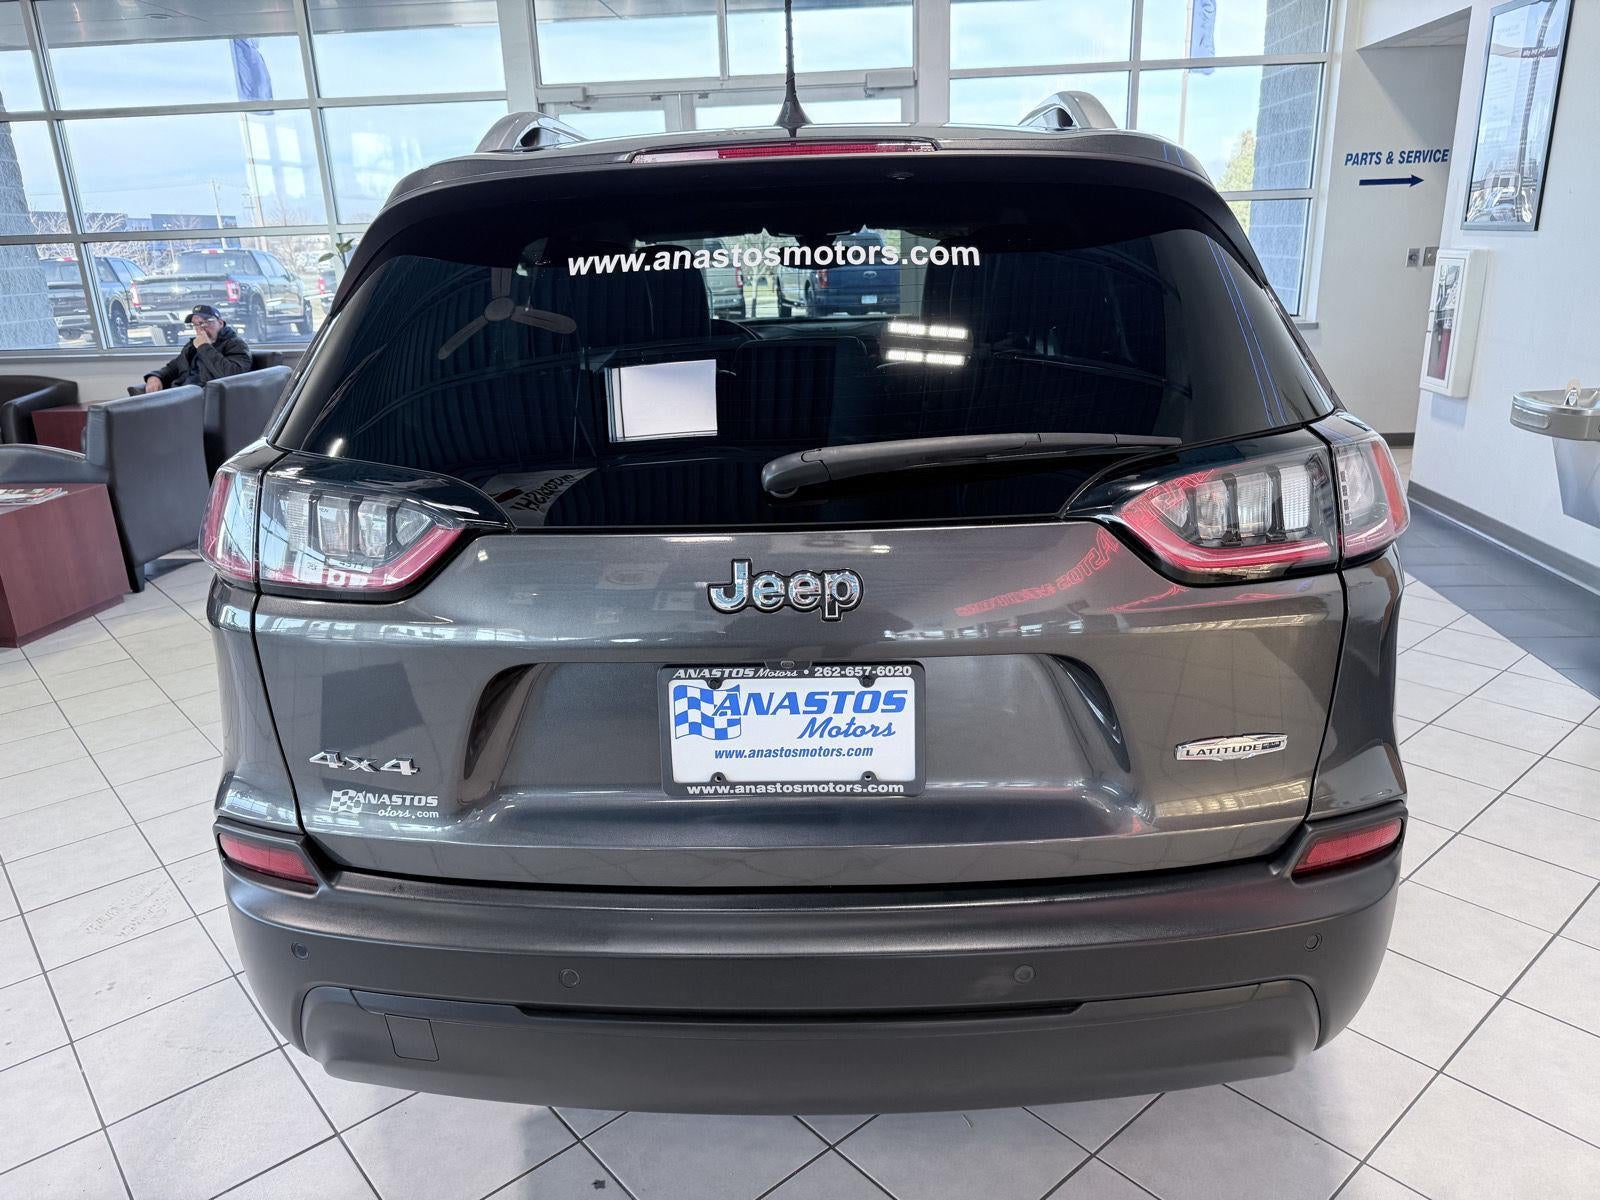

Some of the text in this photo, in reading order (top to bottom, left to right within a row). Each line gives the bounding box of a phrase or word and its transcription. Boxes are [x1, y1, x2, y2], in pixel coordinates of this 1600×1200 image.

[1344, 149, 1450, 166] PARTS & SERVICE
[567, 242, 980, 277] www.anastosmotors.com
[708, 559, 863, 622] Jeep
[672, 666, 912, 679] ANASTOS Motors 262-657-6020
[711, 689, 908, 716] ANASTOS
[796, 716, 896, 740] Motors
[714, 745, 874, 760] www.anastosmotors.com
[1186, 743, 1261, 757] LATITUDE
[309, 750, 421, 776] 4x4
[687, 782, 905, 795] www.anastosmotors.com
[352, 791, 439, 807] ANASTOS
